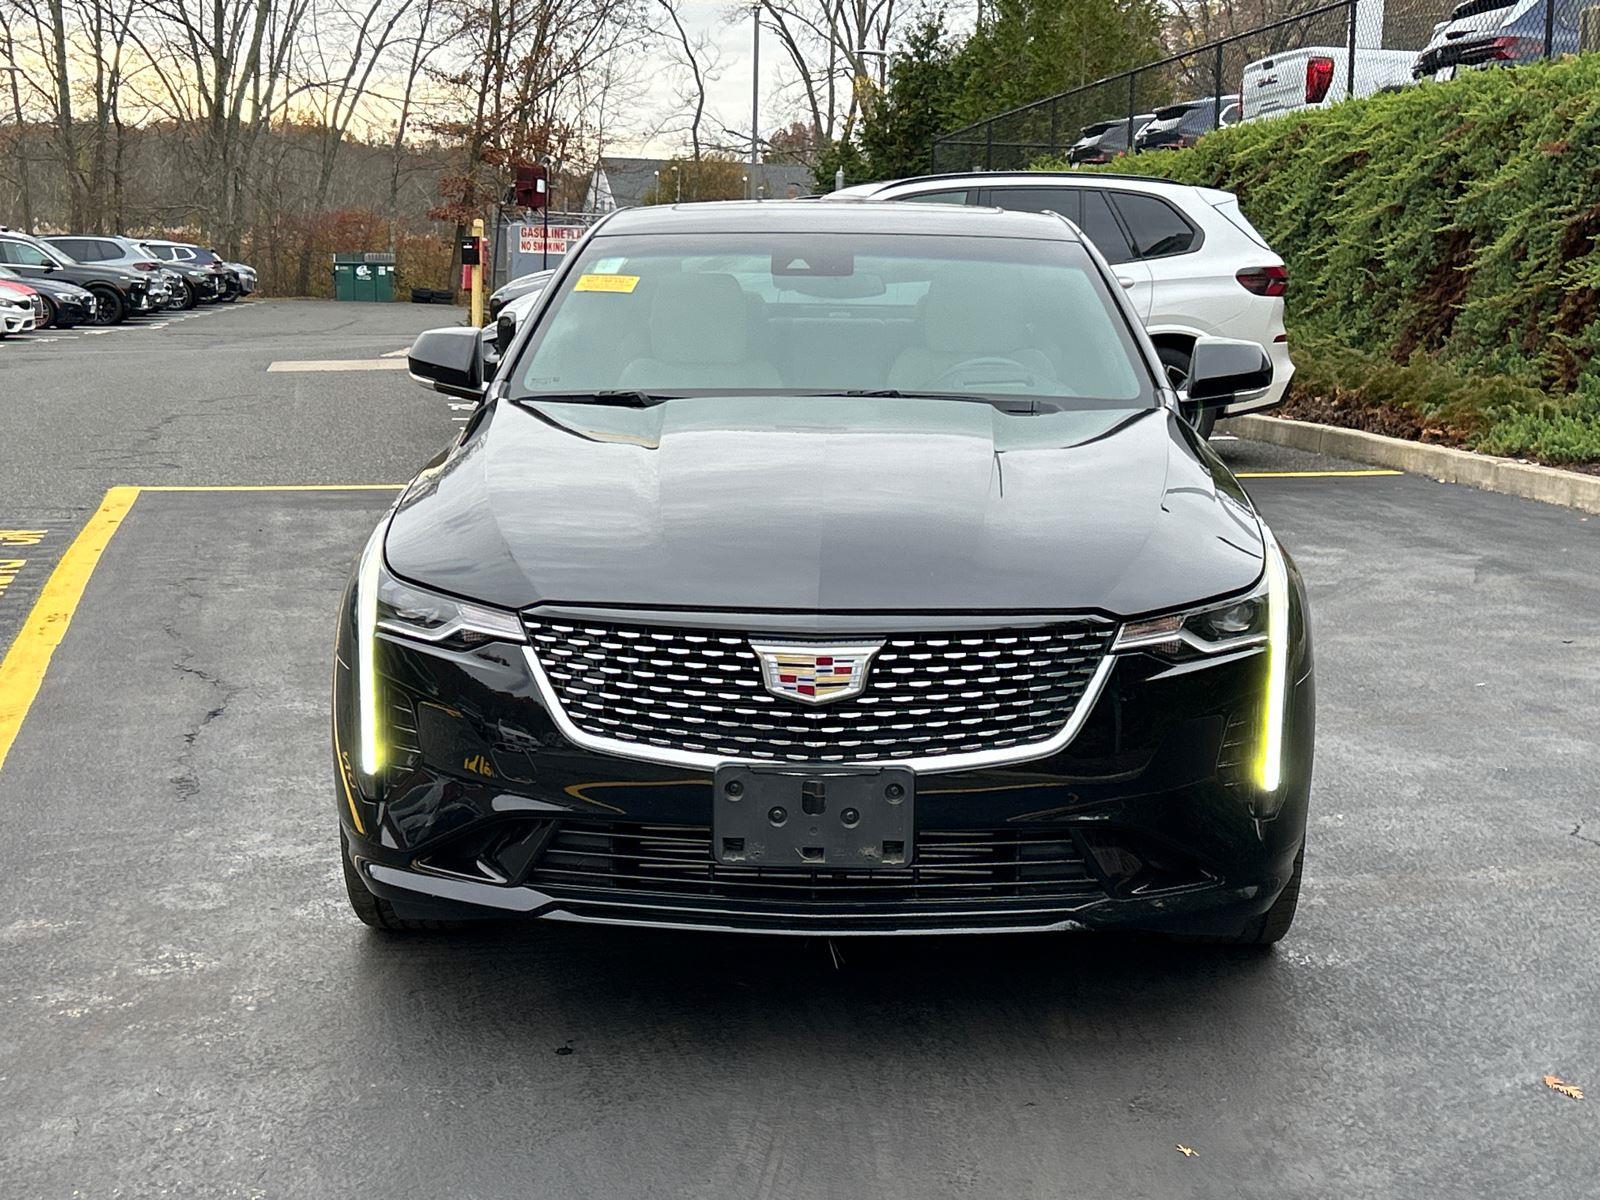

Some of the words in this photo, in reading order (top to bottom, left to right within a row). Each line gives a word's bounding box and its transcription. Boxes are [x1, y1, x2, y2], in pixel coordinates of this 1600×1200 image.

[567, 228, 585, 239] FLA
[521, 241, 531, 250] NO
[533, 241, 565, 252] SMKING
